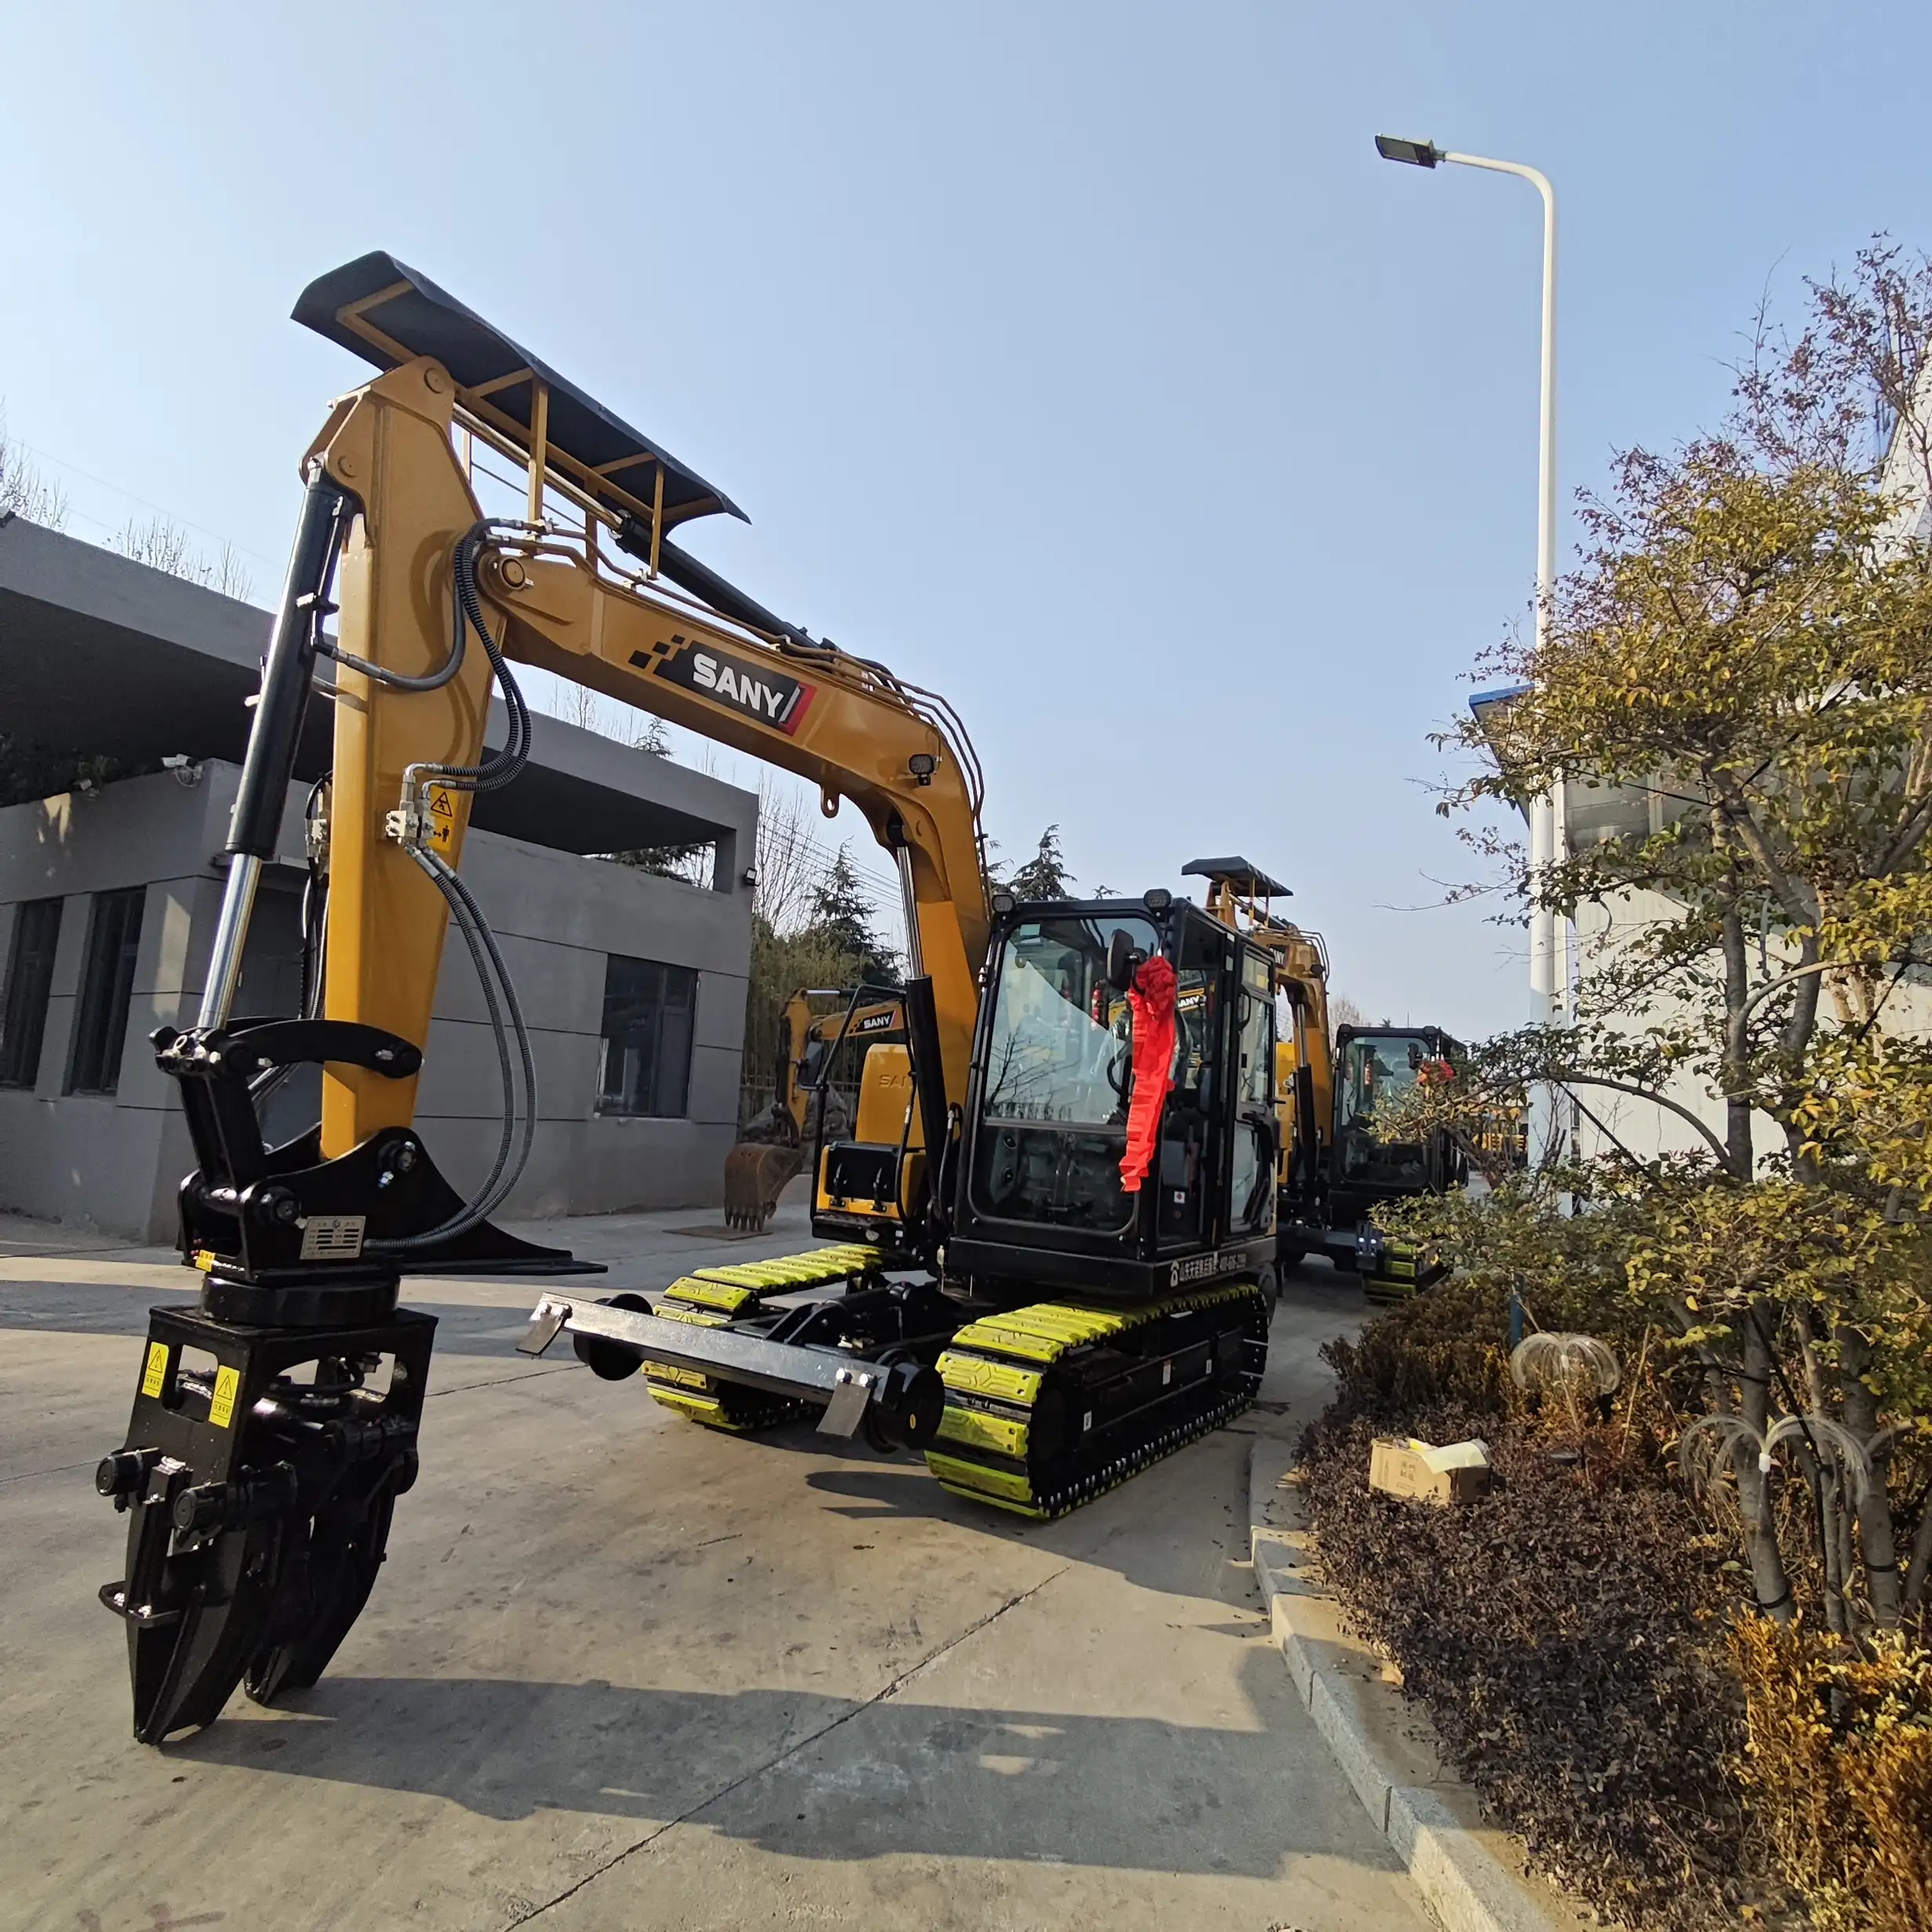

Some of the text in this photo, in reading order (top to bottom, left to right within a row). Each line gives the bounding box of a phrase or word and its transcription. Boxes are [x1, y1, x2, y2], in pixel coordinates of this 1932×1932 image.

[693, 652, 783, 718] SANY
[1178, 993, 1200, 1008] ANY
[863, 1015, 891, 1029] SANY
